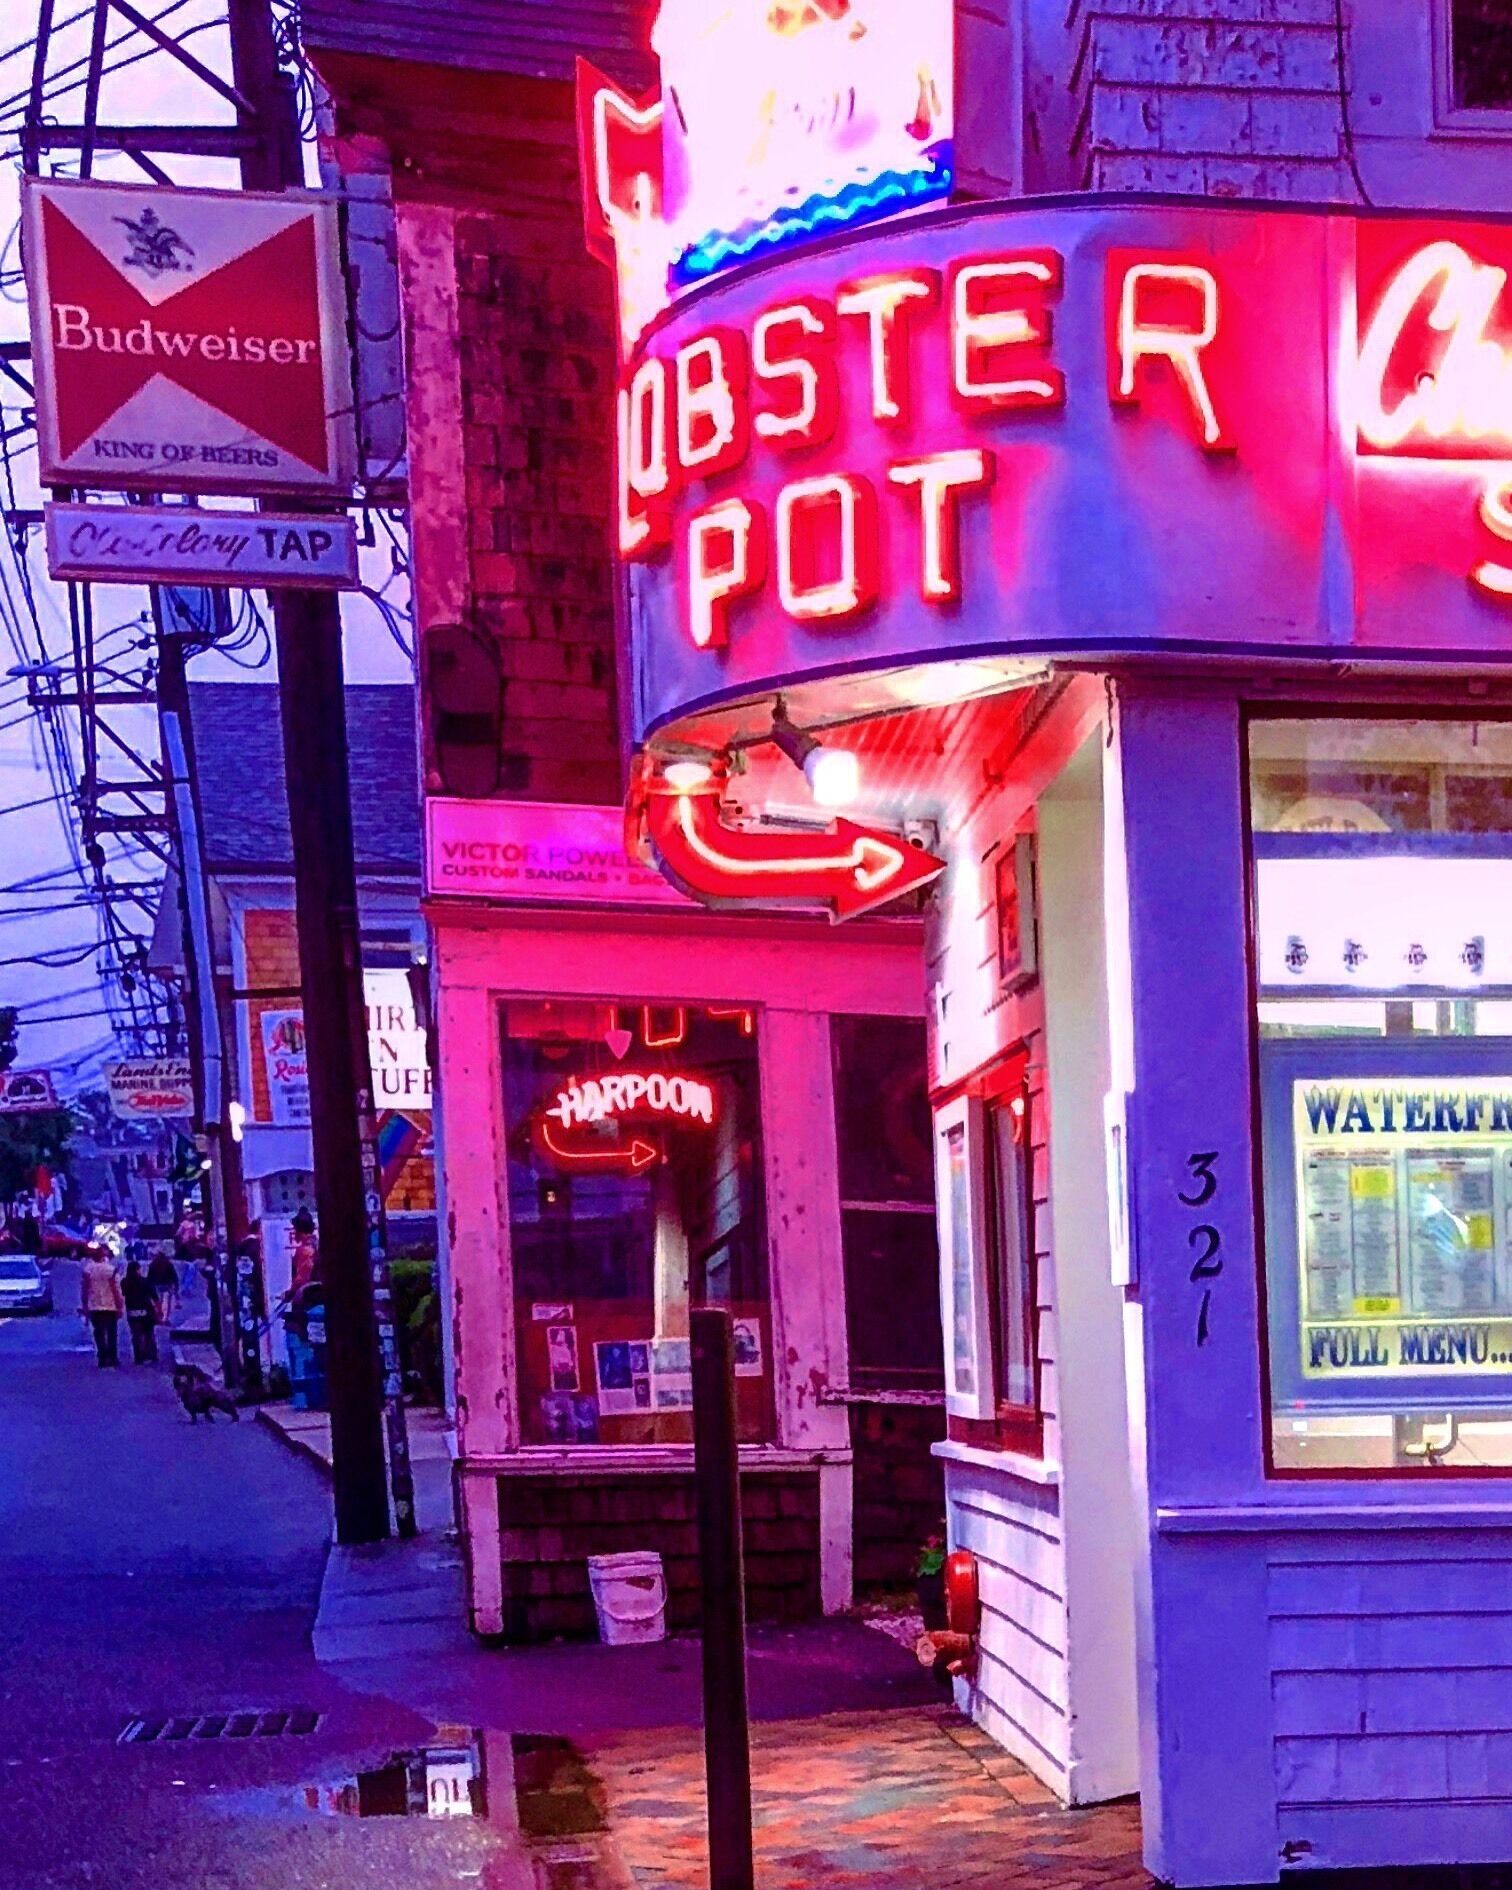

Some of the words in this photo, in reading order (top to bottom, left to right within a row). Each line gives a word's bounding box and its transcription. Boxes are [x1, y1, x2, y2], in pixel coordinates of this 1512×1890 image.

[53, 303, 316, 363] Budweiser
[618, 248, 1232, 558] LOBSTER
[94, 440, 154, 460] KING
[162, 443, 196, 463] OF
[200, 446, 279, 467] BEERS
[257, 527, 332, 562] TAP
[687, 448, 995, 648] POT
[442, 841, 540, 864] VICTOR
[442, 863, 519, 879] CUSTOM
[525, 867, 608, 883] SANDALS
[547, 1072, 713, 1129] HARPOON
[1308, 1325, 1389, 1369] FULL
